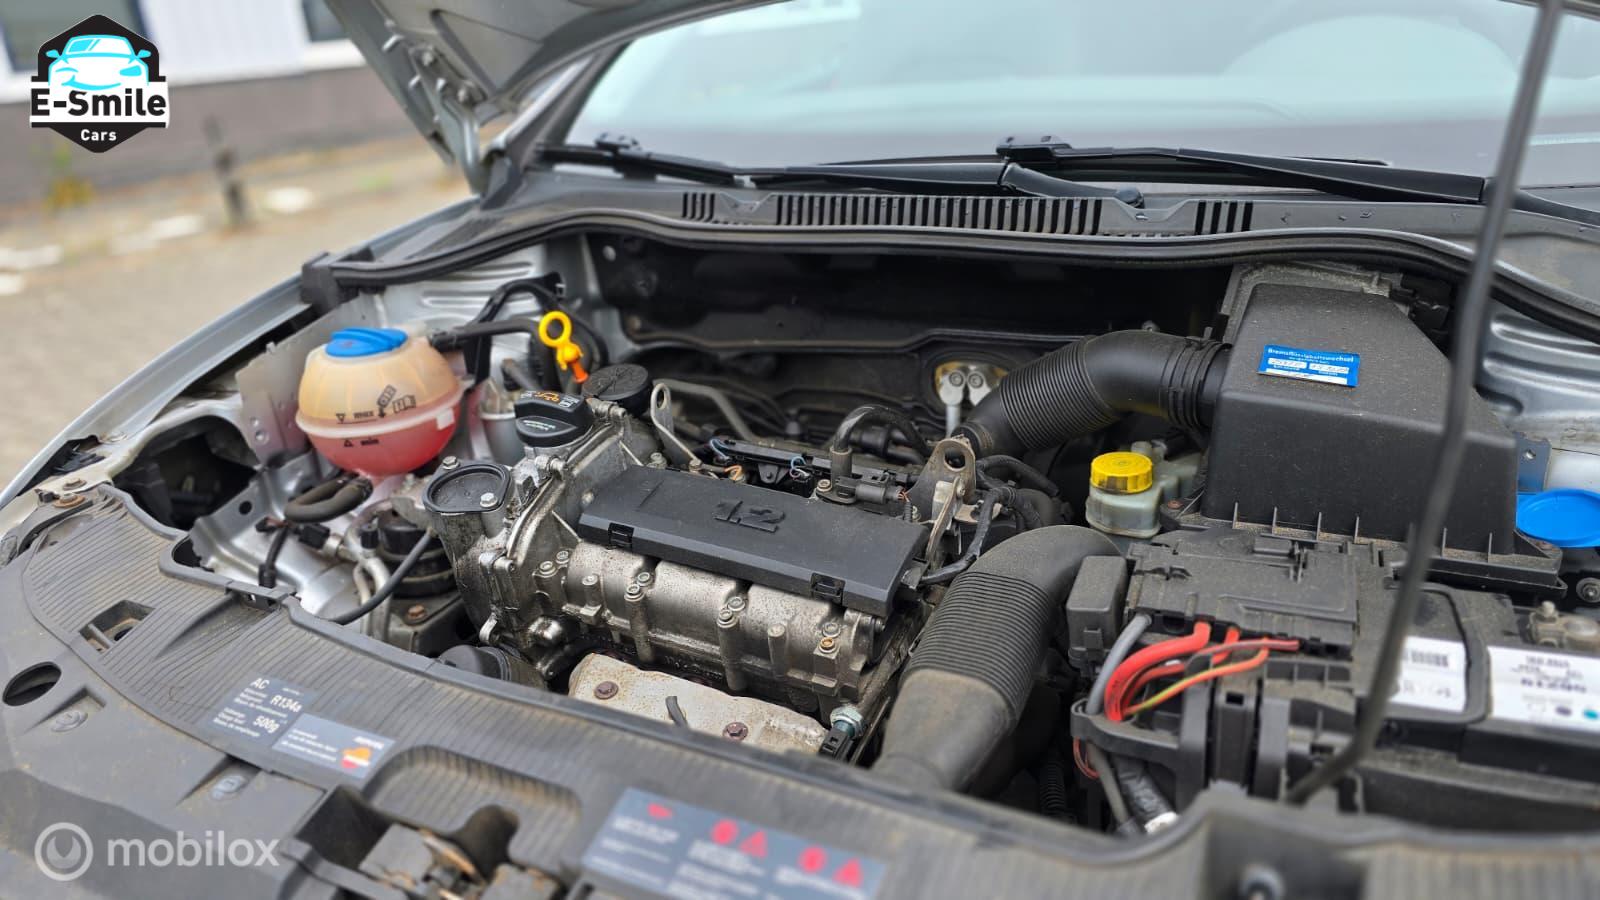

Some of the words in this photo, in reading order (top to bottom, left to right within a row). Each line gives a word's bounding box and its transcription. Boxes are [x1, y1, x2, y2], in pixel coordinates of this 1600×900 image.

[712, 500, 786, 534] 1.2
[250, 677, 270, 690] AC
[252, 715, 280, 734] 500g
